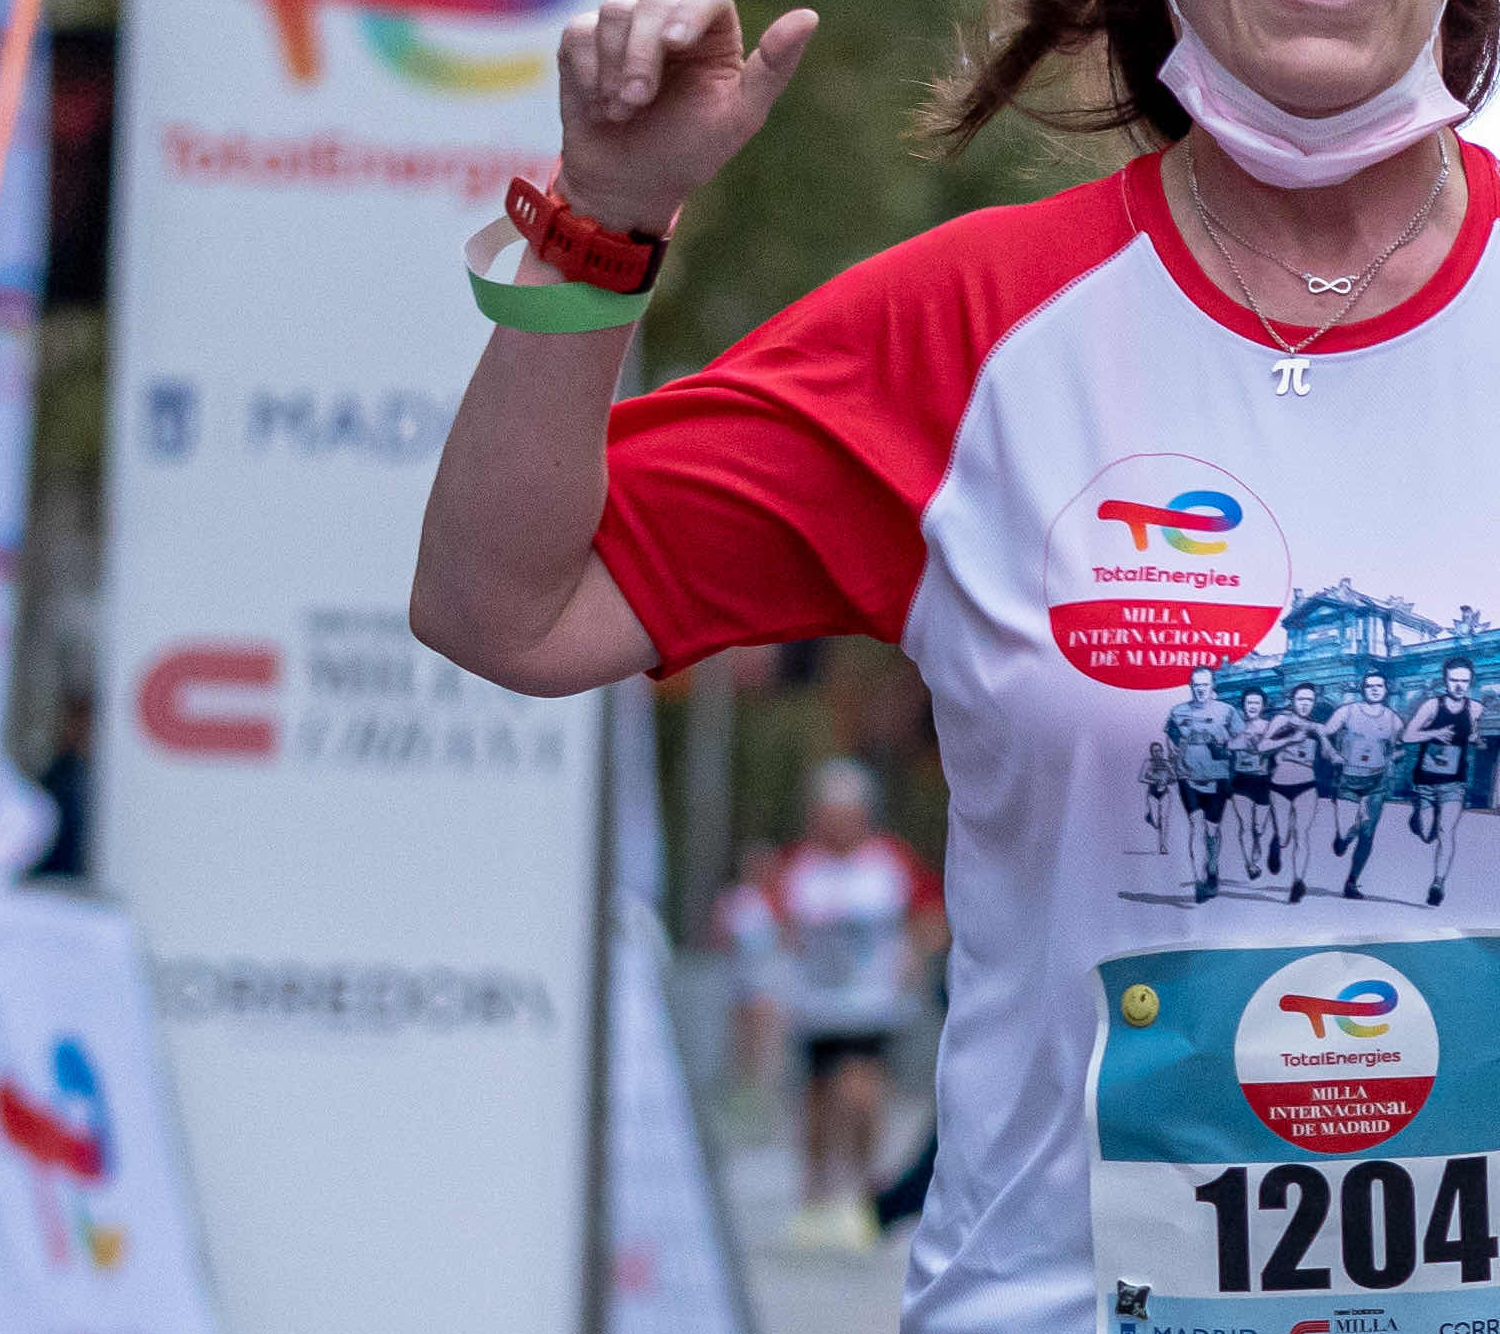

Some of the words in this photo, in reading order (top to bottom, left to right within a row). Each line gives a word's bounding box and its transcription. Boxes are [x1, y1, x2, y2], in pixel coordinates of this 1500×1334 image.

[245, 385, 452, 462] MAD
[1092, 566, 1241, 589] TotalEnergies
[1122, 607, 1191, 625] MILLA
[1089, 650, 1120, 666] DE
[1126, 650, 1218, 667] MADRID
[1281, 1049, 1402, 1068] TotalEnergies
[1311, 1085, 1368, 1101] MILLA
[1291, 1122, 1317, 1137] DE
[1320, 1119, 1391, 1136] MADRID
[1194, 1156, 1499, 1293] 1204
[1335, 1317, 1401, 1334] MILLA
